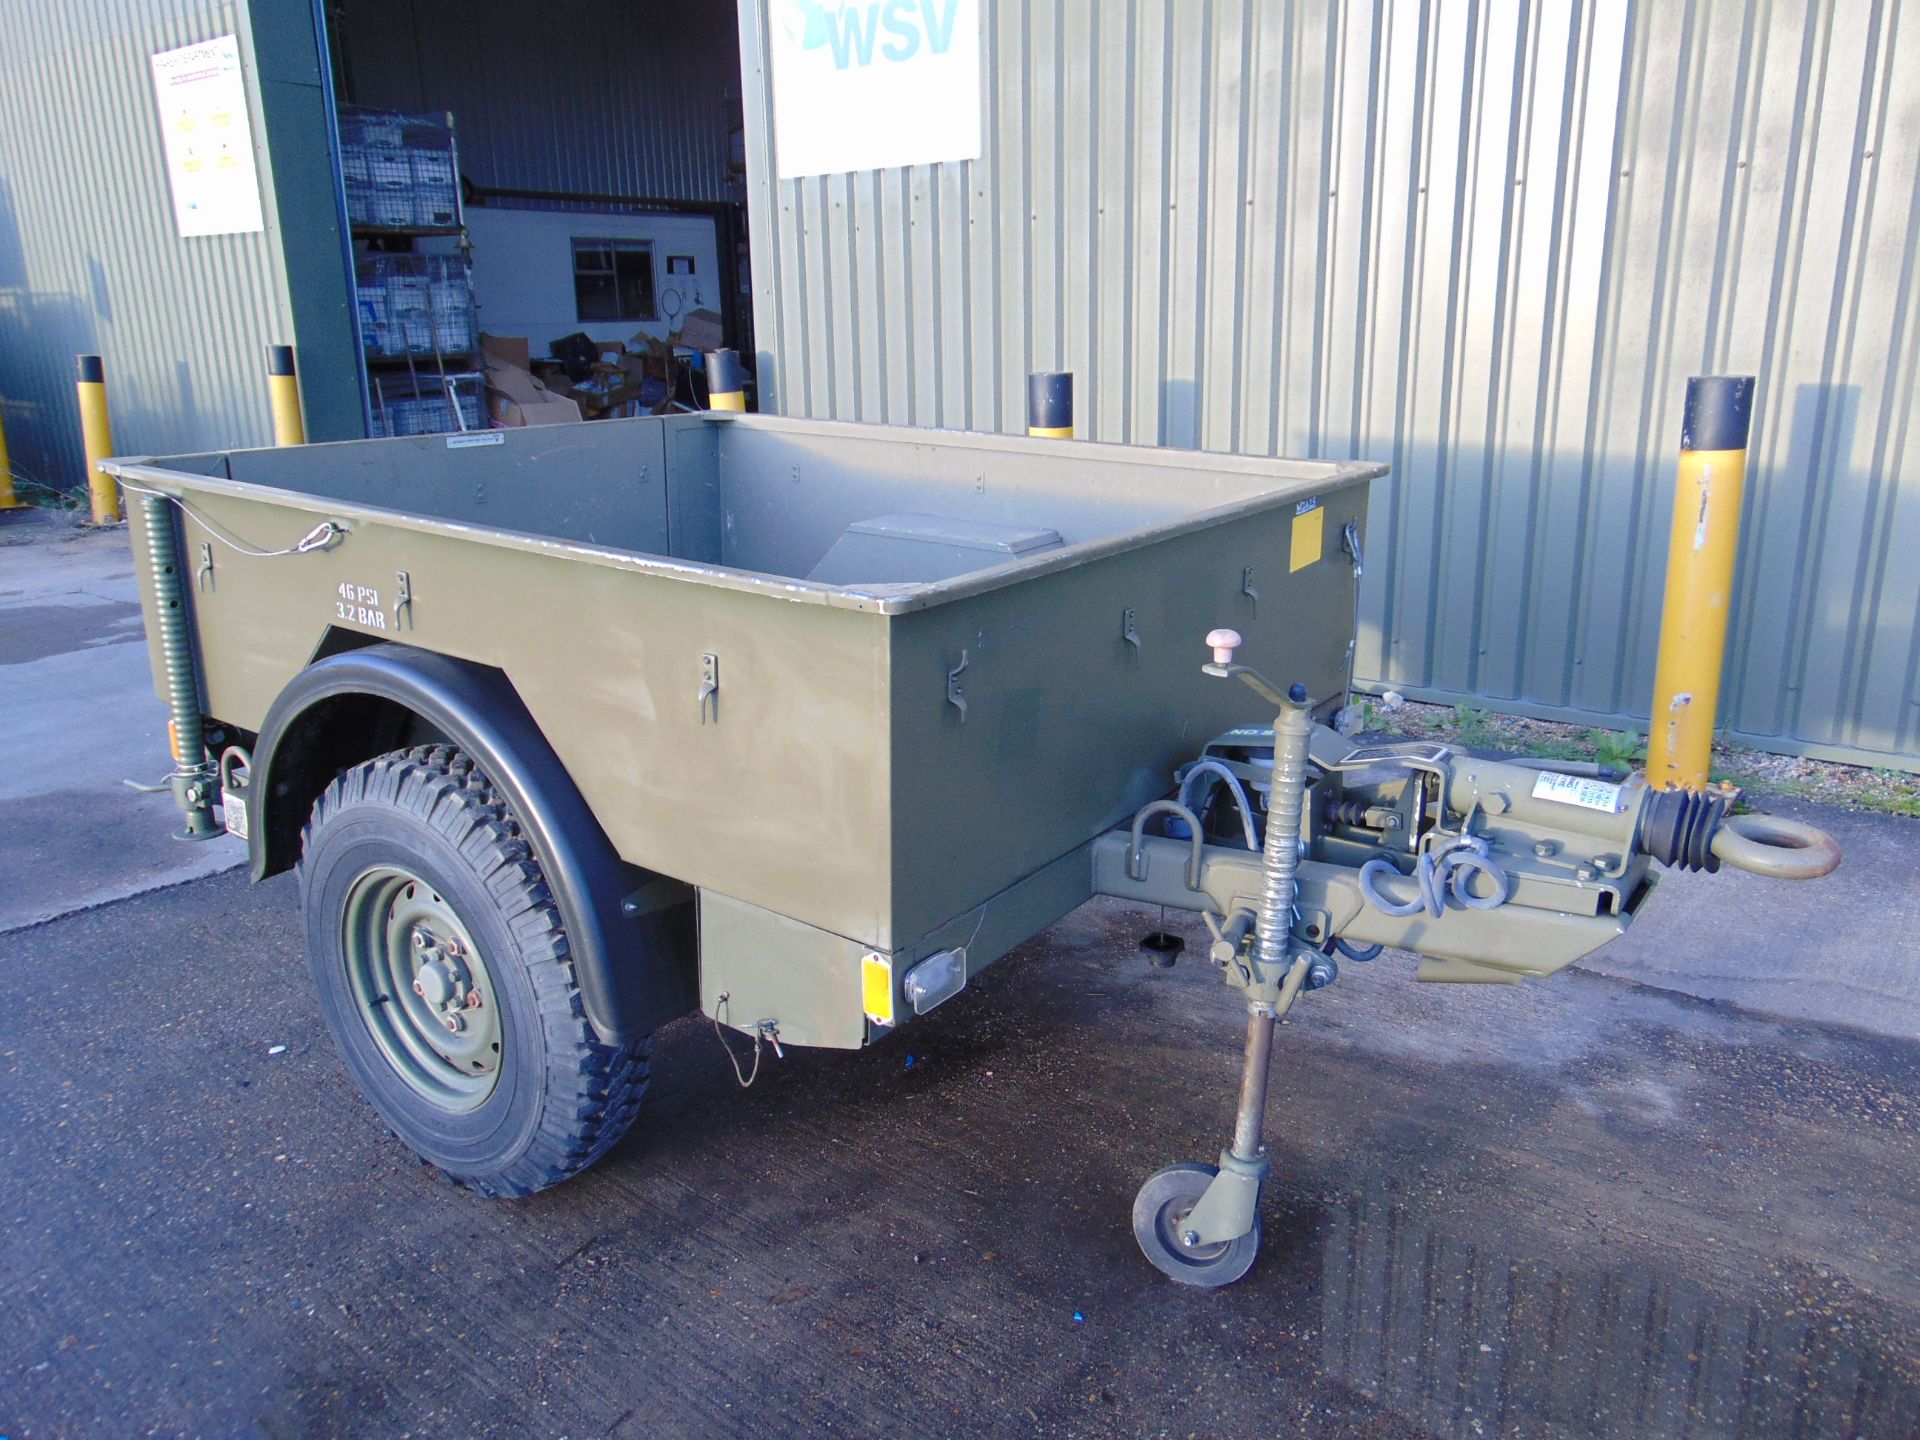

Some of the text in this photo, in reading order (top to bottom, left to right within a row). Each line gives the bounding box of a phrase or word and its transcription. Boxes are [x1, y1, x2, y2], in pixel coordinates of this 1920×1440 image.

[823, 0, 960, 71] WSV
[338, 582, 379, 606] 46 PSI
[336, 601, 386, 630] 3.2 BAR
